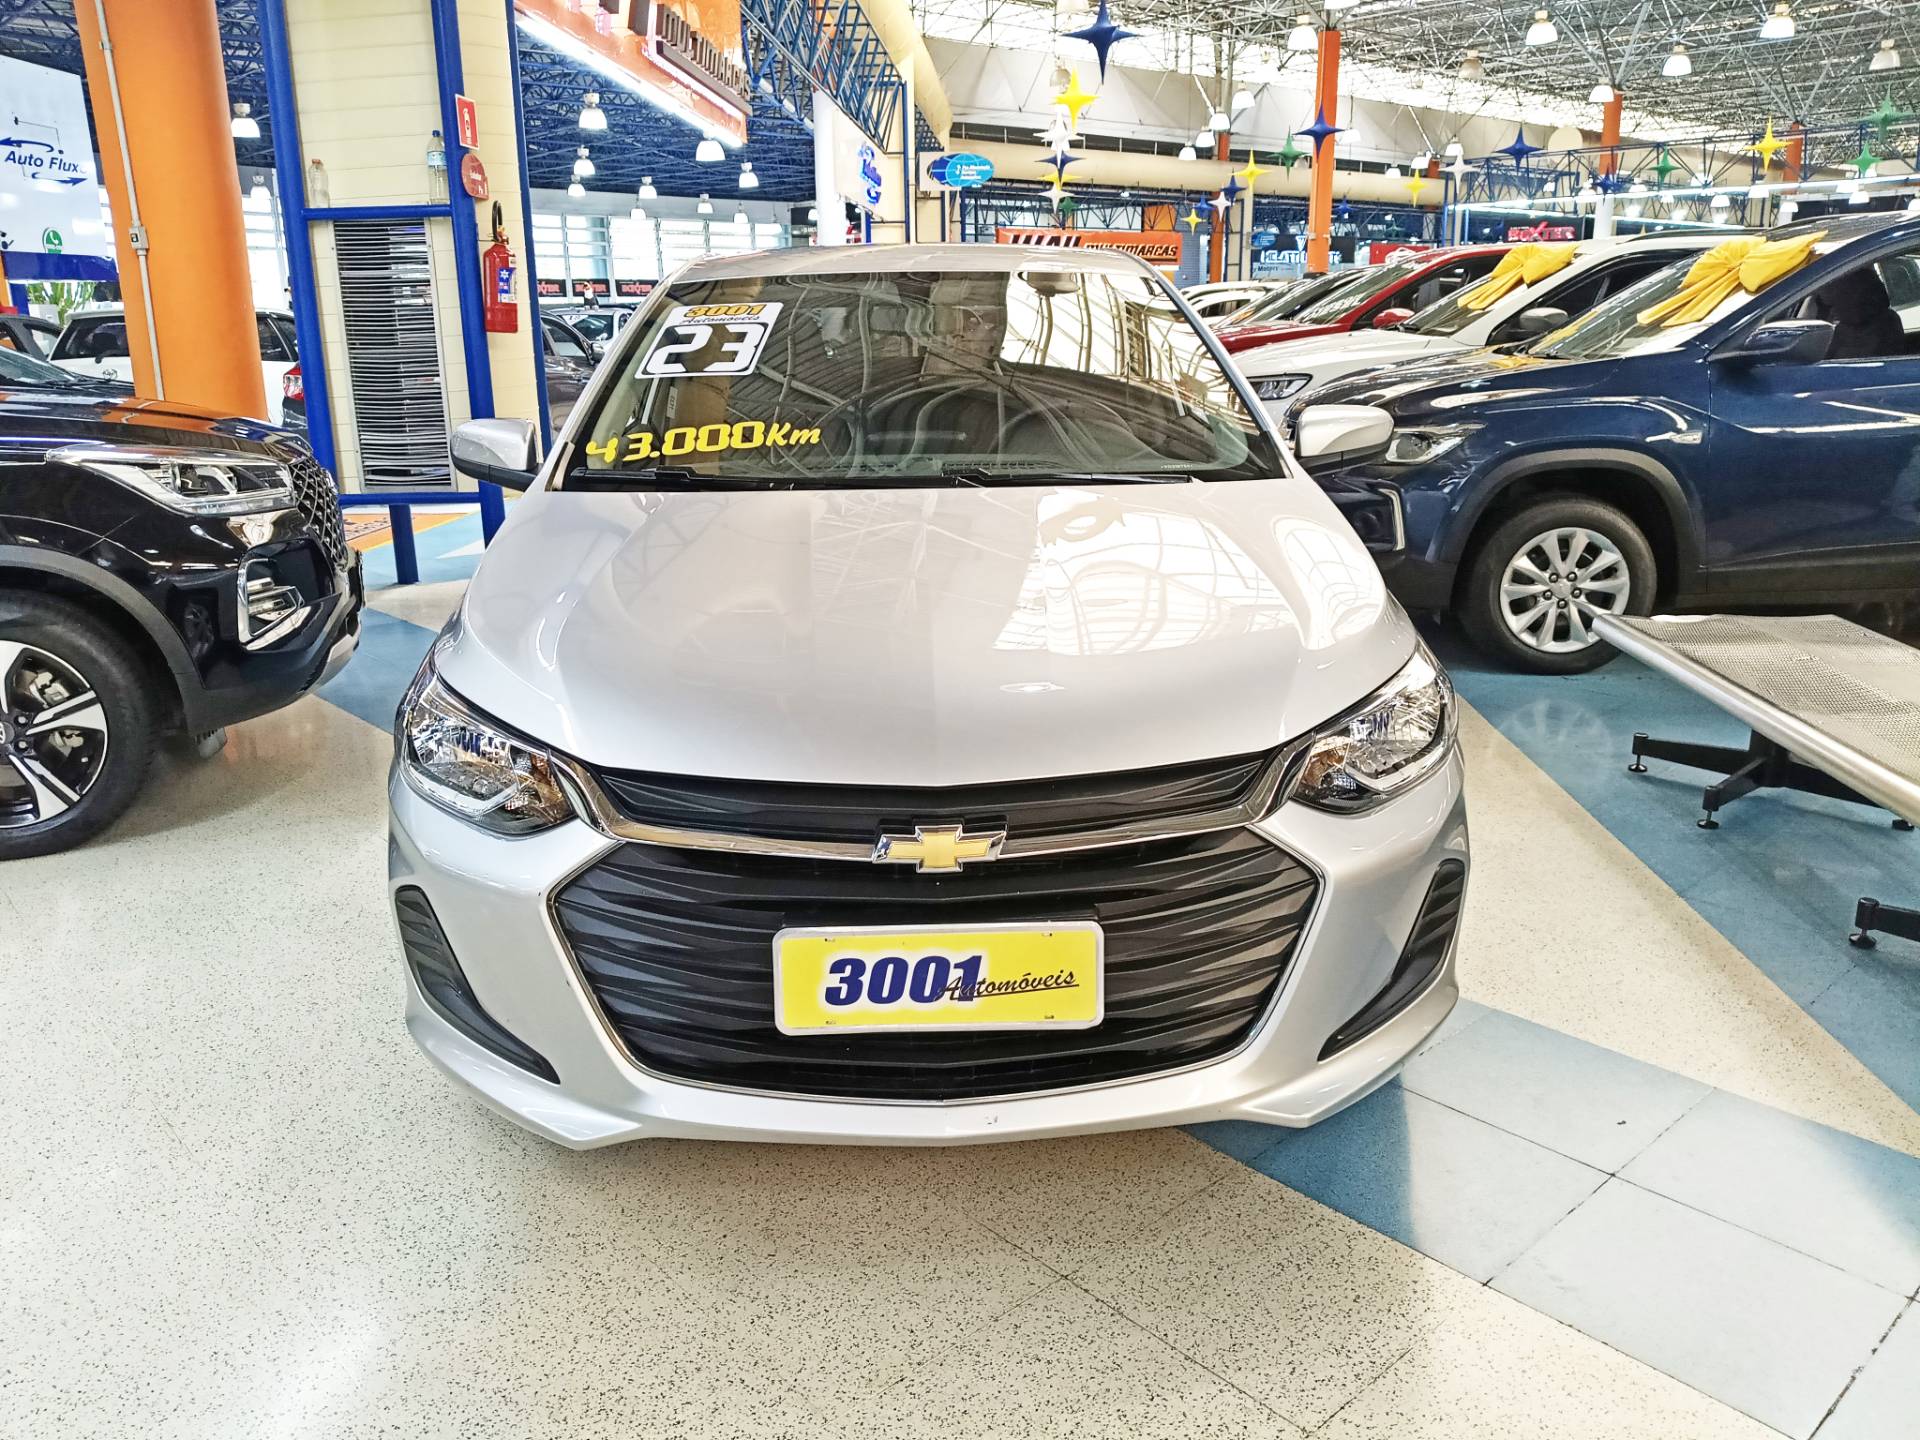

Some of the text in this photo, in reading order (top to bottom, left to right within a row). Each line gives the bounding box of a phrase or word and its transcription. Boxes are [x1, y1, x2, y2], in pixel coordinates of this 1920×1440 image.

[5, 151, 44, 168] Auto
[684, 304, 767, 317] 3001
[645, 322, 765, 374] 23
[824, 955, 1078, 1006] 3001 Automóveis
